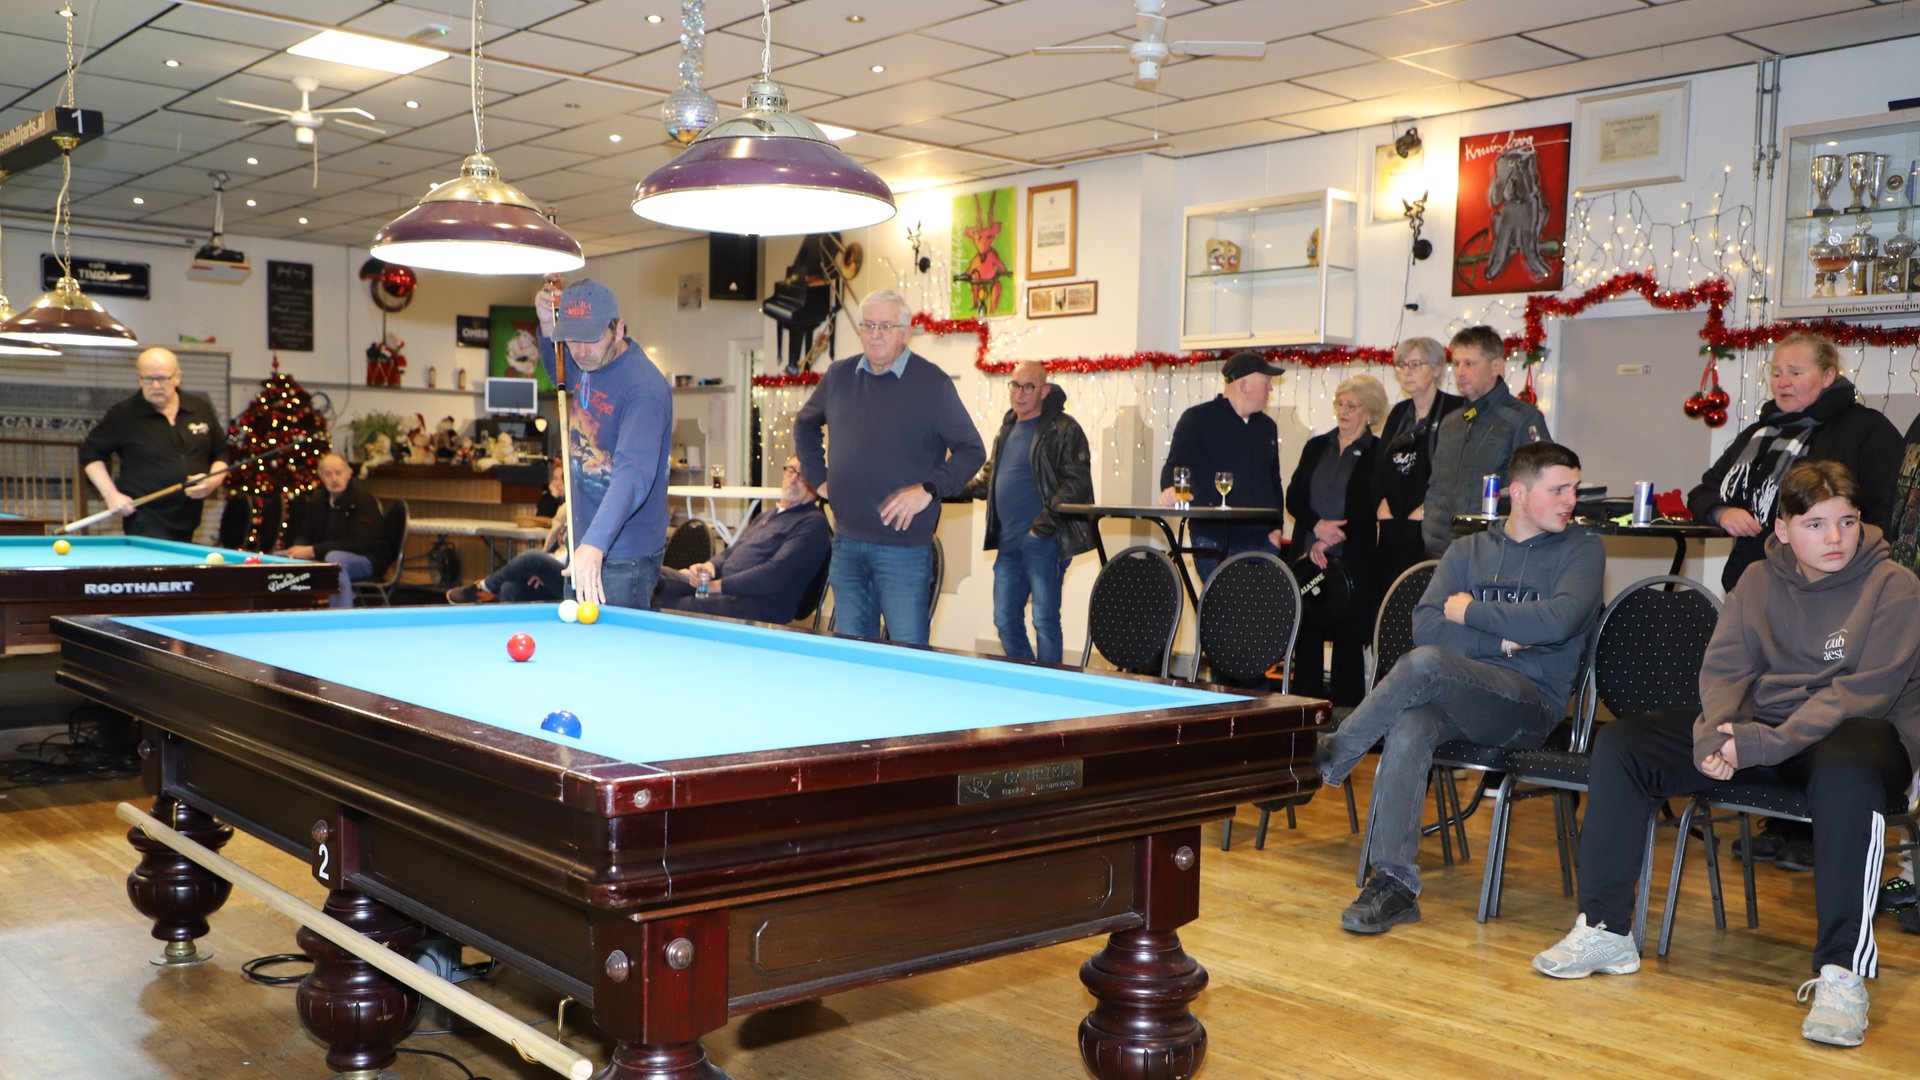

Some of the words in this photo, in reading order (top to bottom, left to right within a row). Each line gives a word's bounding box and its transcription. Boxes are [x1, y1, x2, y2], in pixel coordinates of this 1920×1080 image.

[71, 109, 84, 134] 1
[1827, 301, 1920, 314] Kruisboogverenigin
[84, 581, 194, 595] ROOTHAERT
[318, 843, 330, 881] 2
